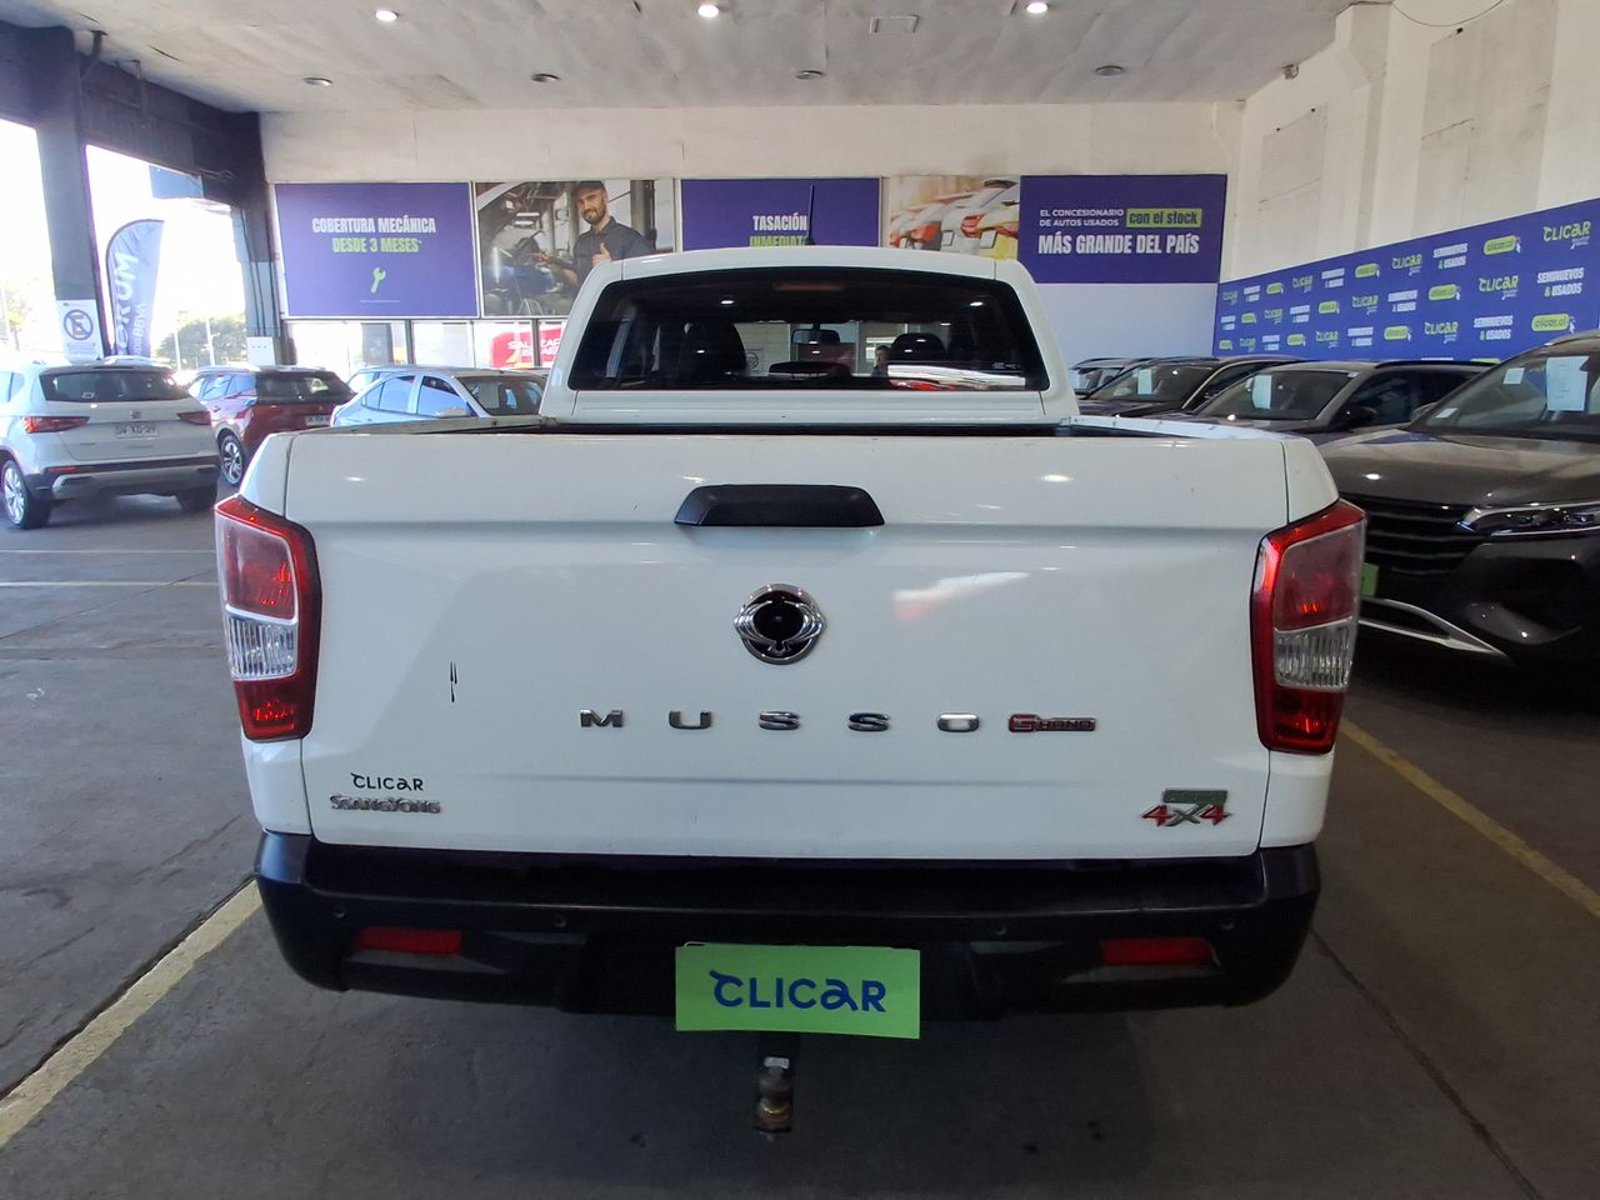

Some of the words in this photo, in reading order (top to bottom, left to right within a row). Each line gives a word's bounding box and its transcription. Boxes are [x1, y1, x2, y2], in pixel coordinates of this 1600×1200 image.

[752, 211, 808, 231] TASACIÓN
[1040, 209, 1051, 217] EL
[1052, 209, 1125, 217] CONCESIONARIO
[1040, 219, 1052, 227] DE
[1053, 219, 1082, 227] AUTOS
[1084, 219, 1119, 227] USADOS
[1129, 212, 1149, 225] con
[1152, 211, 1164, 225] el
[1166, 211, 1198, 225] stock
[312, 217, 376, 234] COBERTURA
[378, 214, 437, 234] MECÁNICA
[332, 238, 368, 253] DESDE
[369, 238, 378, 252] 3
[1038, 230, 1072, 255] MÁS
[1075, 234, 1133, 254] GRANDE
[1135, 234, 1162, 254] DEL
[113, 251, 140, 356] ORUM
[579, 710, 981, 732] MUSSO
